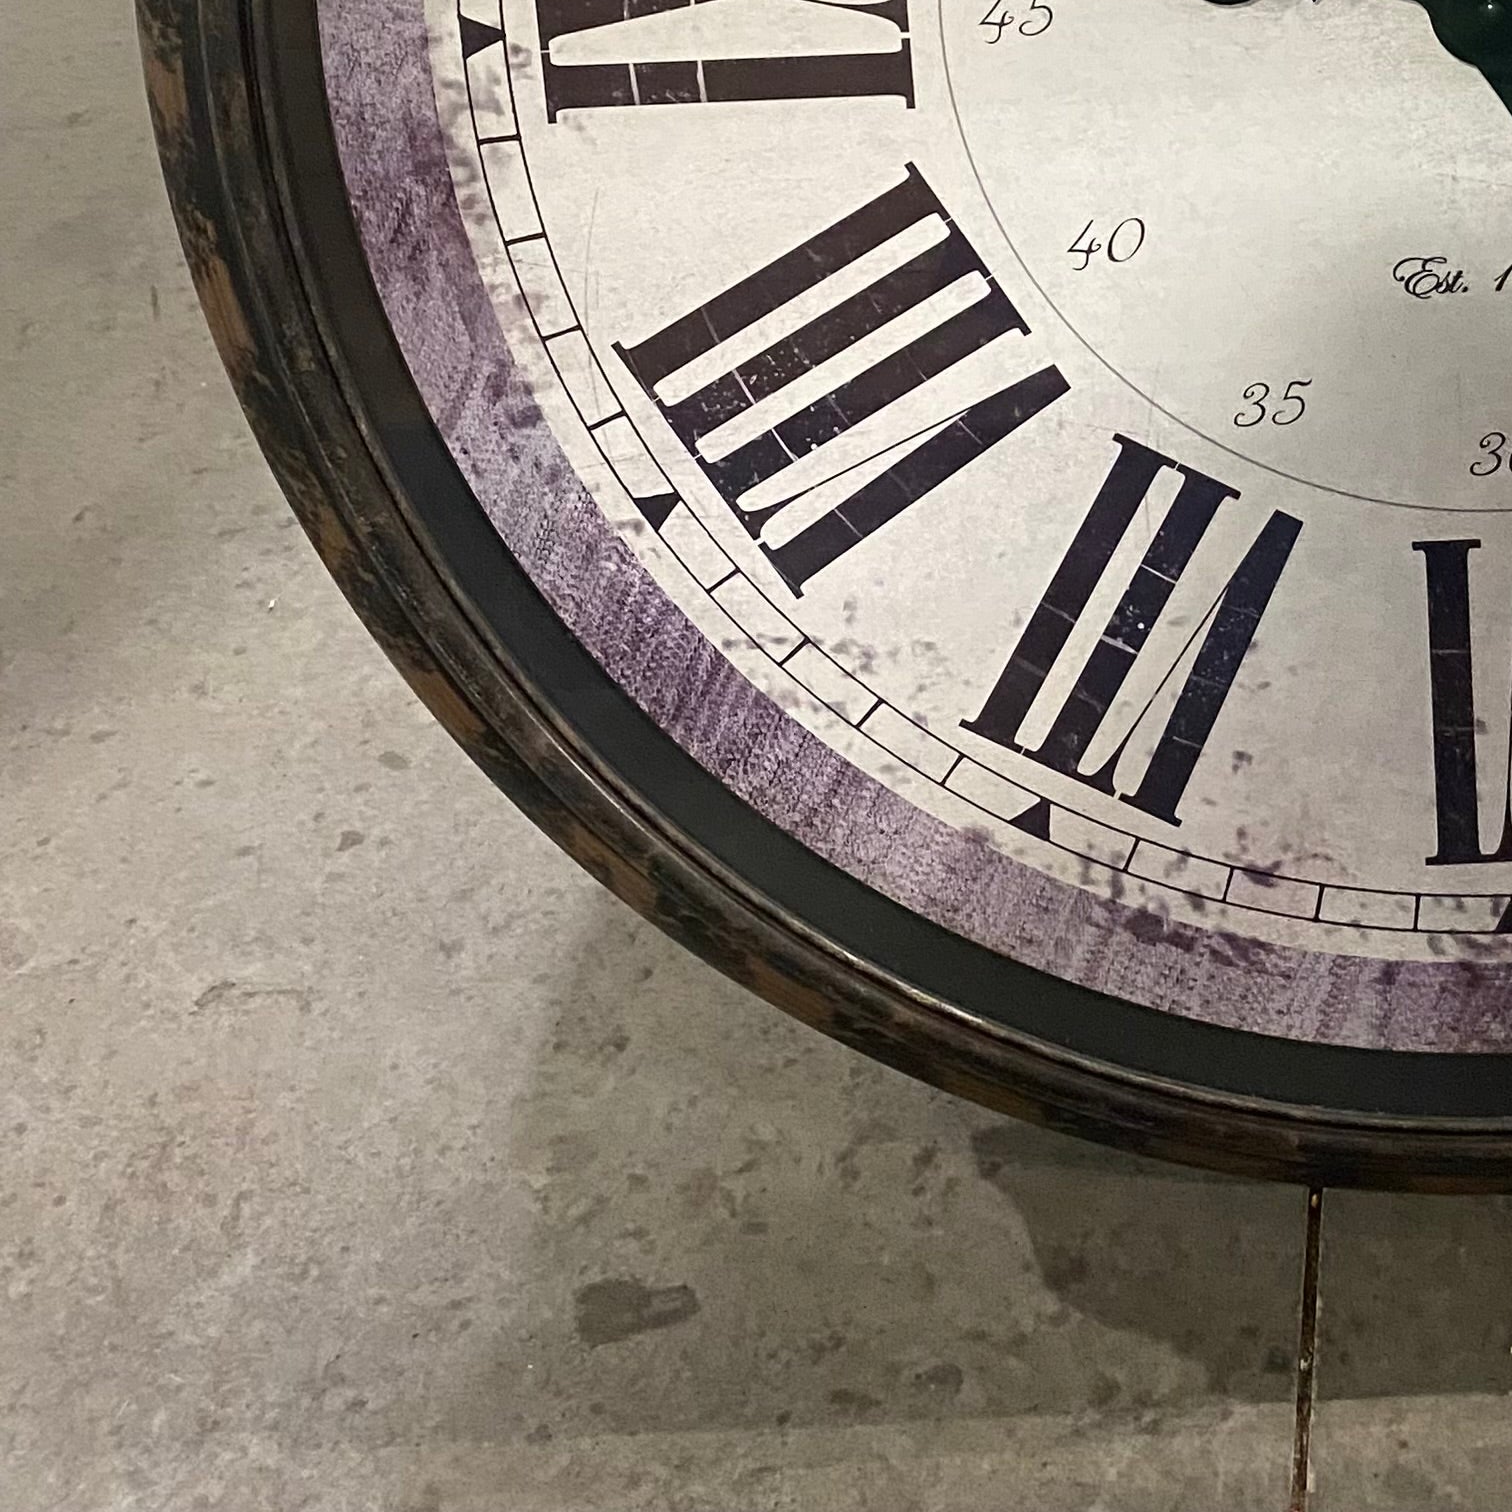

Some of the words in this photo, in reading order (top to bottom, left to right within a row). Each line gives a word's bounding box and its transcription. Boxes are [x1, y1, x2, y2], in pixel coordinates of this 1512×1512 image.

[1066, 217, 1146, 271] 40
[1393, 256, 1469, 299] Est.
[1232, 378, 1313, 428] 35
